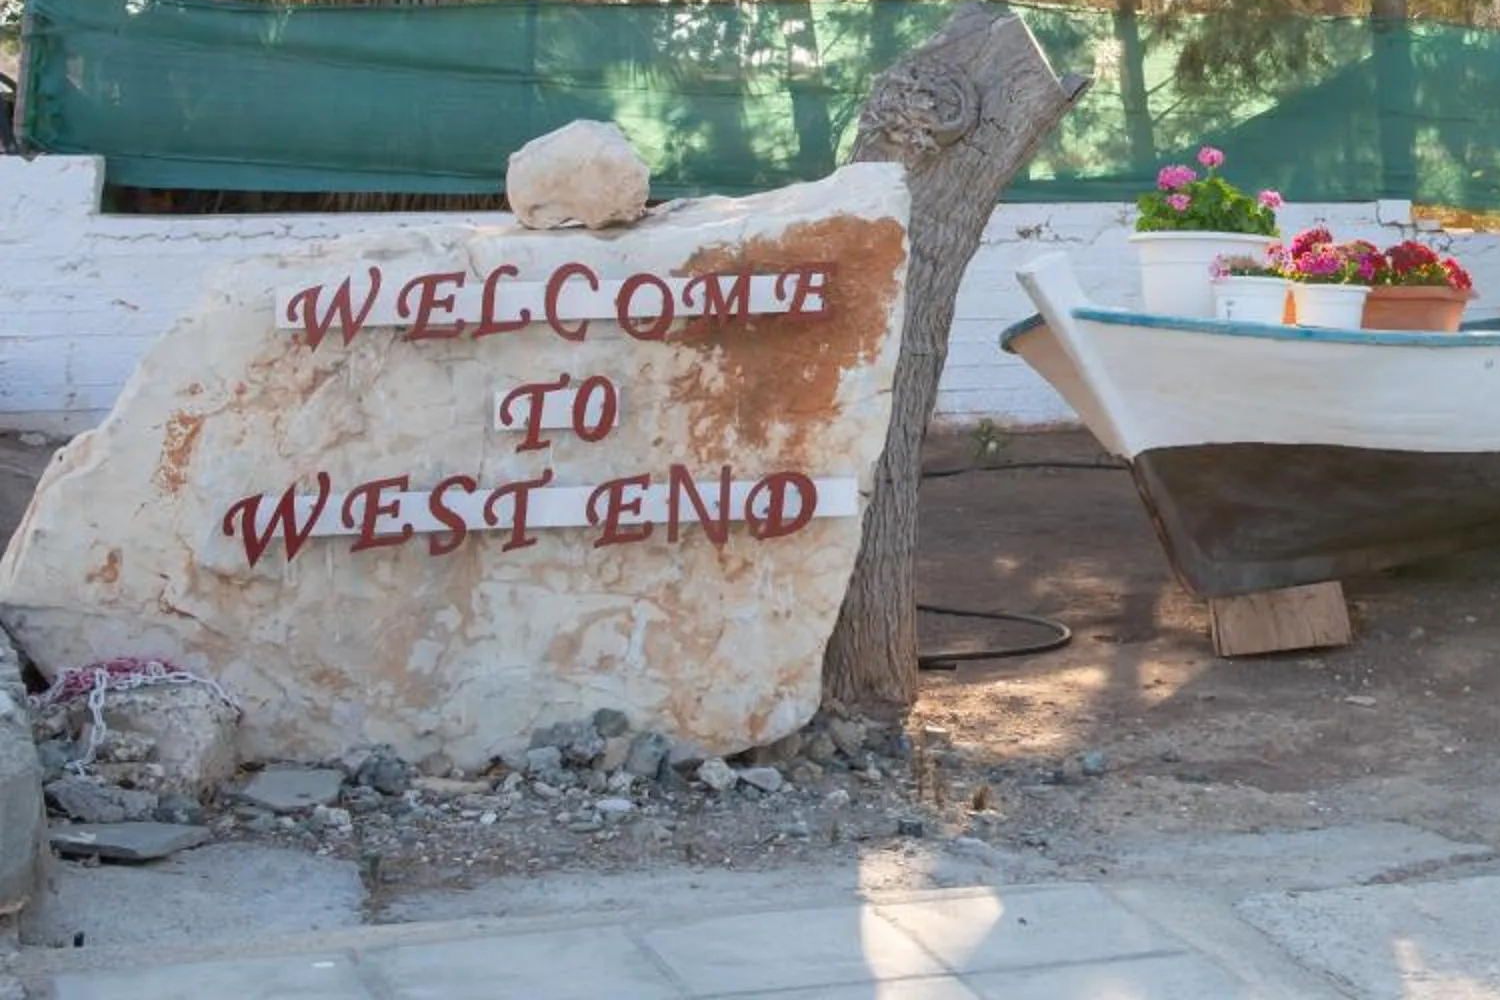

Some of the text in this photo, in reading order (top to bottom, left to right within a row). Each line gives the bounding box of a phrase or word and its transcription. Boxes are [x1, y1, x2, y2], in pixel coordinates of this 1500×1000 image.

[287, 262, 838, 353] WELCOME
[500, 373, 617, 453] TO
[223, 464, 818, 568] WEST END
